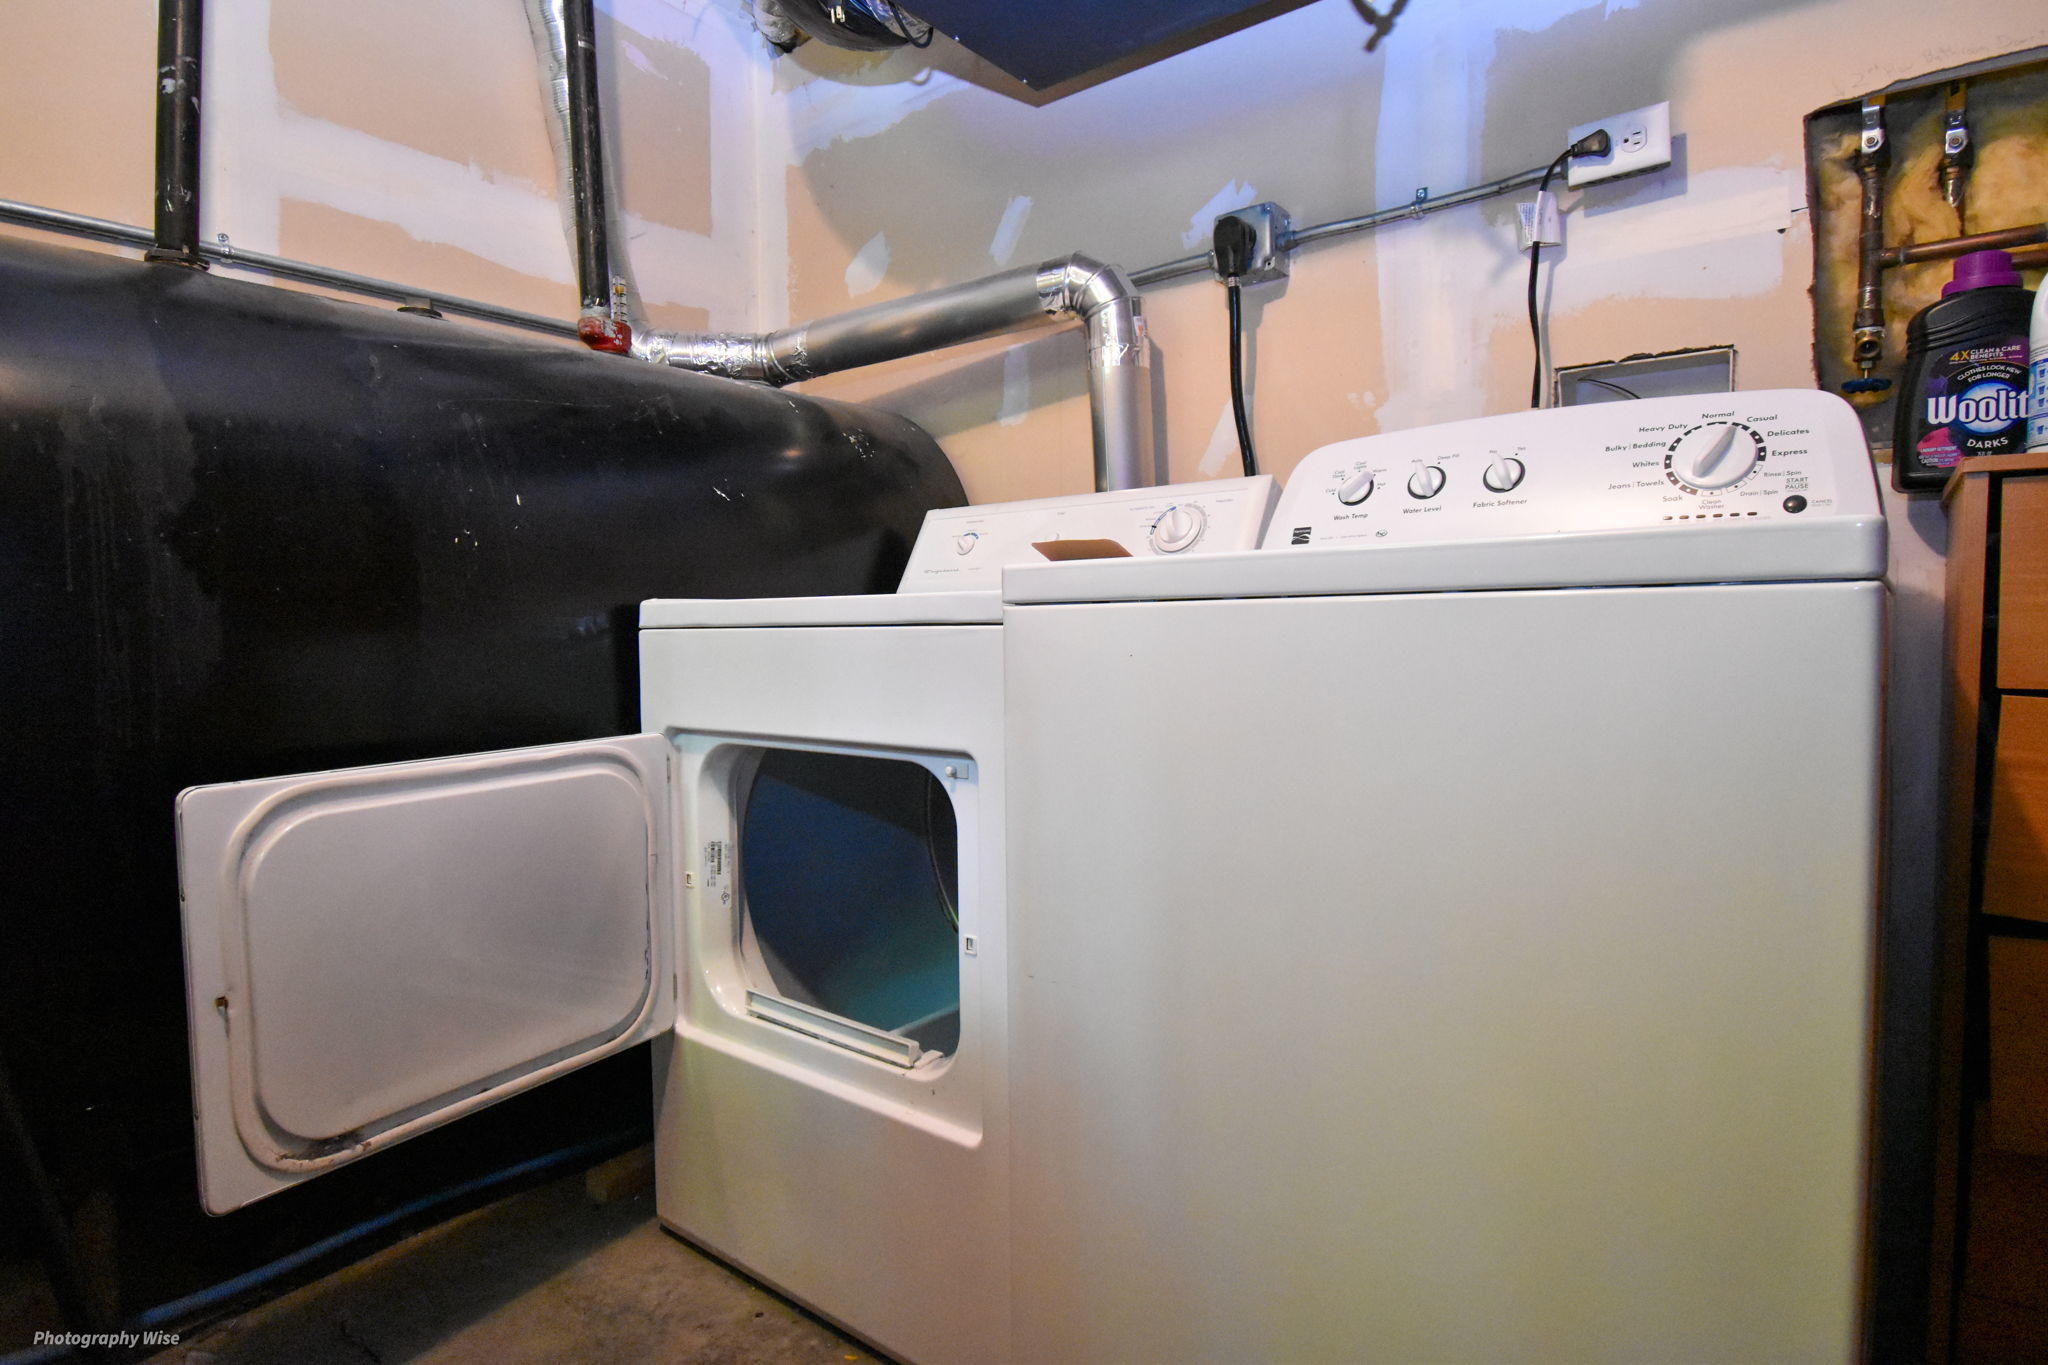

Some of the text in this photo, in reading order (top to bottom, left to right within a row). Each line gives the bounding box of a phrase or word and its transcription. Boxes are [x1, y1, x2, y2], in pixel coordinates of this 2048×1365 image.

[1949, 350, 1971, 361] 4X
[1970, 347, 1995, 355] CLEAN
[1970, 352, 2004, 360] BENEFITS
[1957, 365, 1987, 381] CLOTHES
[2006, 366, 2022, 374] NEW
[1967, 371, 2010, 383] FOR LONGER
[1927, 389, 2030, 425] Woolit
[1701, 410, 1735, 419] Normal
[1746, 414, 1778, 423] Casual
[1638, 422, 1688, 434] Heavy Duty
[1766, 428, 1810, 437] Delicates
[1605, 440, 1667, 453] Bulky Bedding
[1966, 436, 2009, 449] DARKS
[1771, 448, 1808, 457] Express
[1632, 459, 1660, 469] Whites
[1608, 479, 1665, 490] Jeans Towels
[1472, 498, 1528, 508] Fabric Softener
[1662, 494, 1683, 503] Soak
[1402, 505, 1442, 514] Water Level
[1351, 512, 1369, 520] Temp
